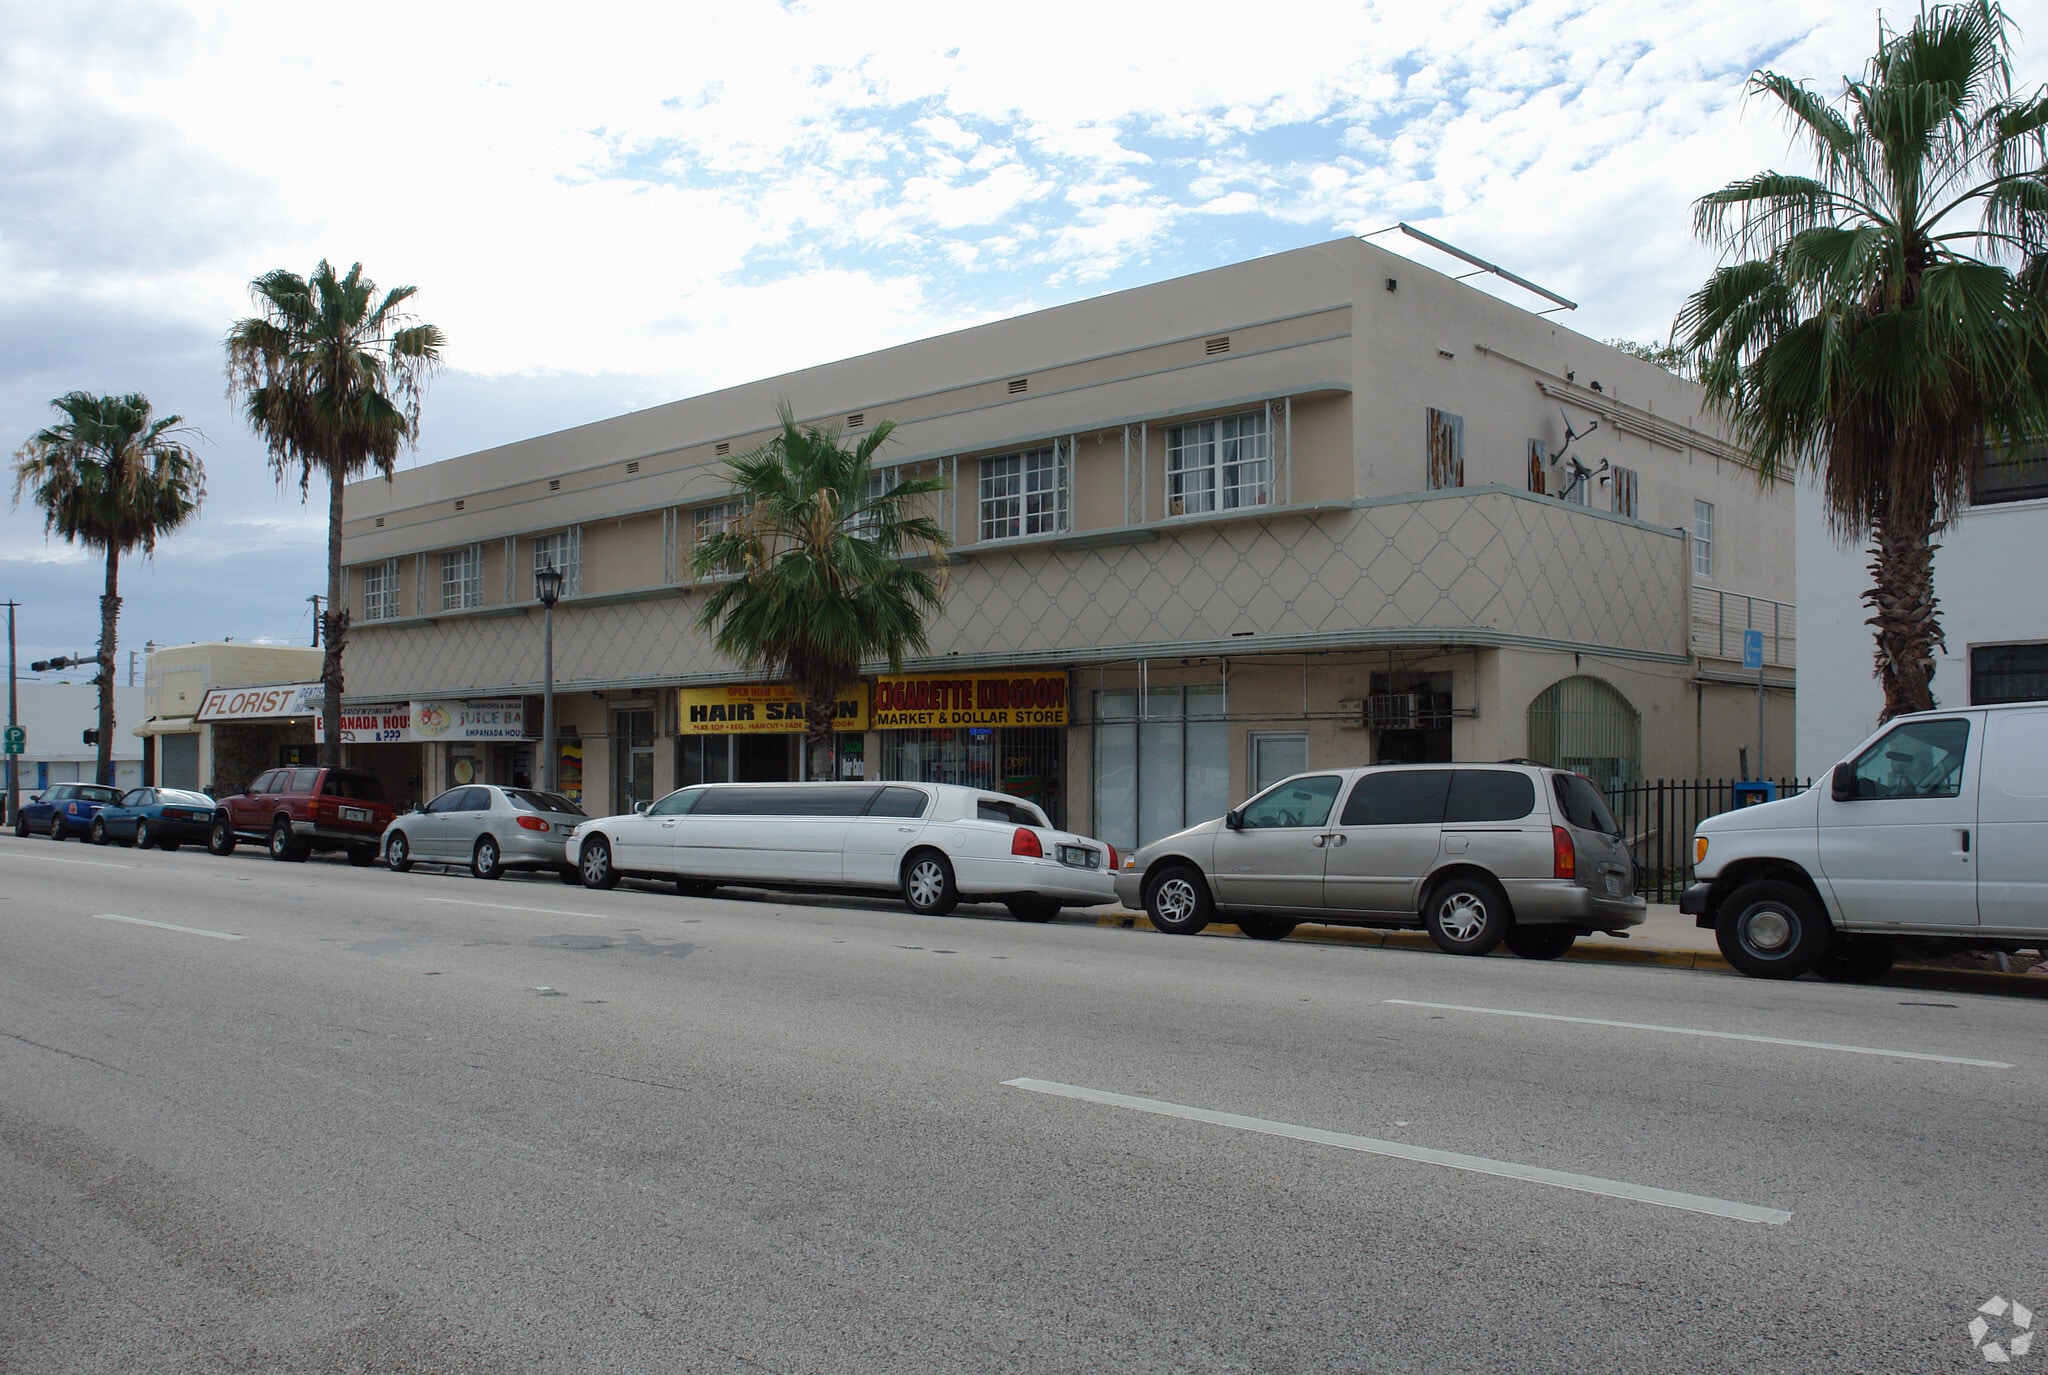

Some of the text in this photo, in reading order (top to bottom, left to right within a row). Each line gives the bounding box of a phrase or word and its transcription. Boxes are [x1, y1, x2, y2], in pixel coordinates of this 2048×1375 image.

[728, 686, 749, 697] OPEN
[751, 686, 771, 697] NOW
[877, 678, 1065, 711] CIGARETTE KINGDOM
[204, 690, 295, 716] FLORIST
[459, 711, 499, 726] JUICE
[690, 701, 858, 723] HAIR SAN
[878, 711, 1063, 725] MARKET & DOLLAR STORE
[317, 716, 378, 730] EANADA
[11, 730, 20, 741] P
[375, 730, 401, 742] & ???
[466, 729, 503, 737] EMPANADA
